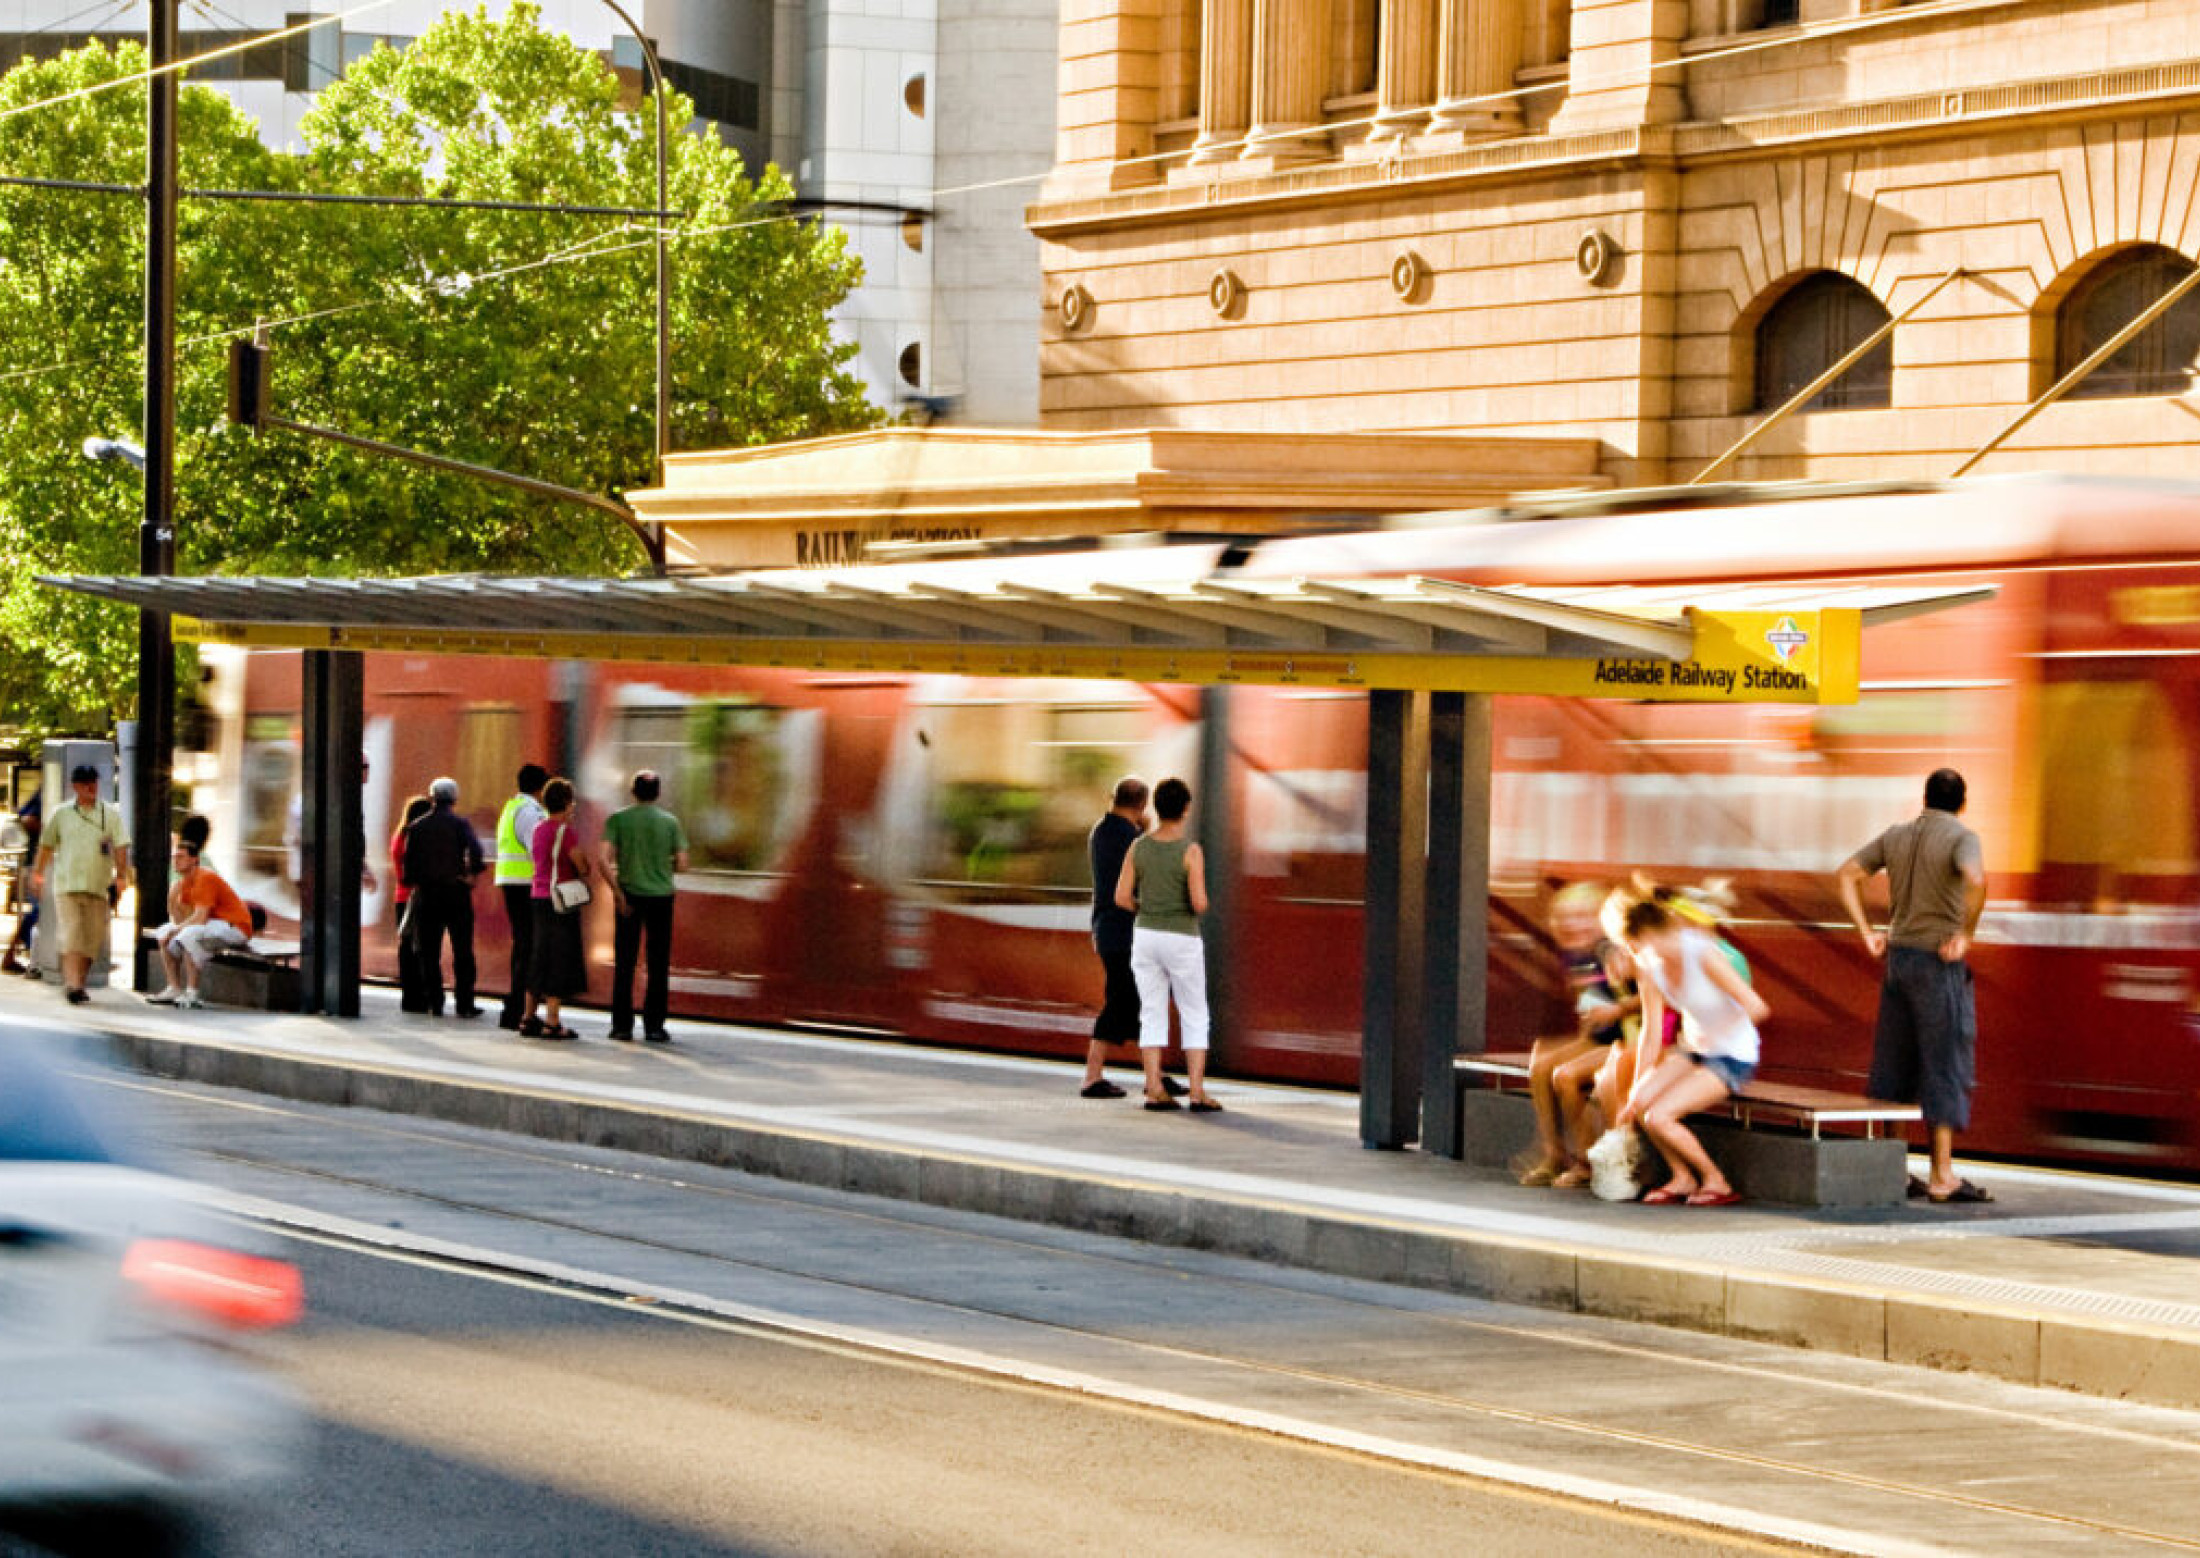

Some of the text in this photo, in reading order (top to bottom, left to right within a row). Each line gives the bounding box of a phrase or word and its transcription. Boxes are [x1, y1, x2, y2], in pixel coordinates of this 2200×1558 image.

[1595, 658, 1807, 694] Adelaide Railway Station
